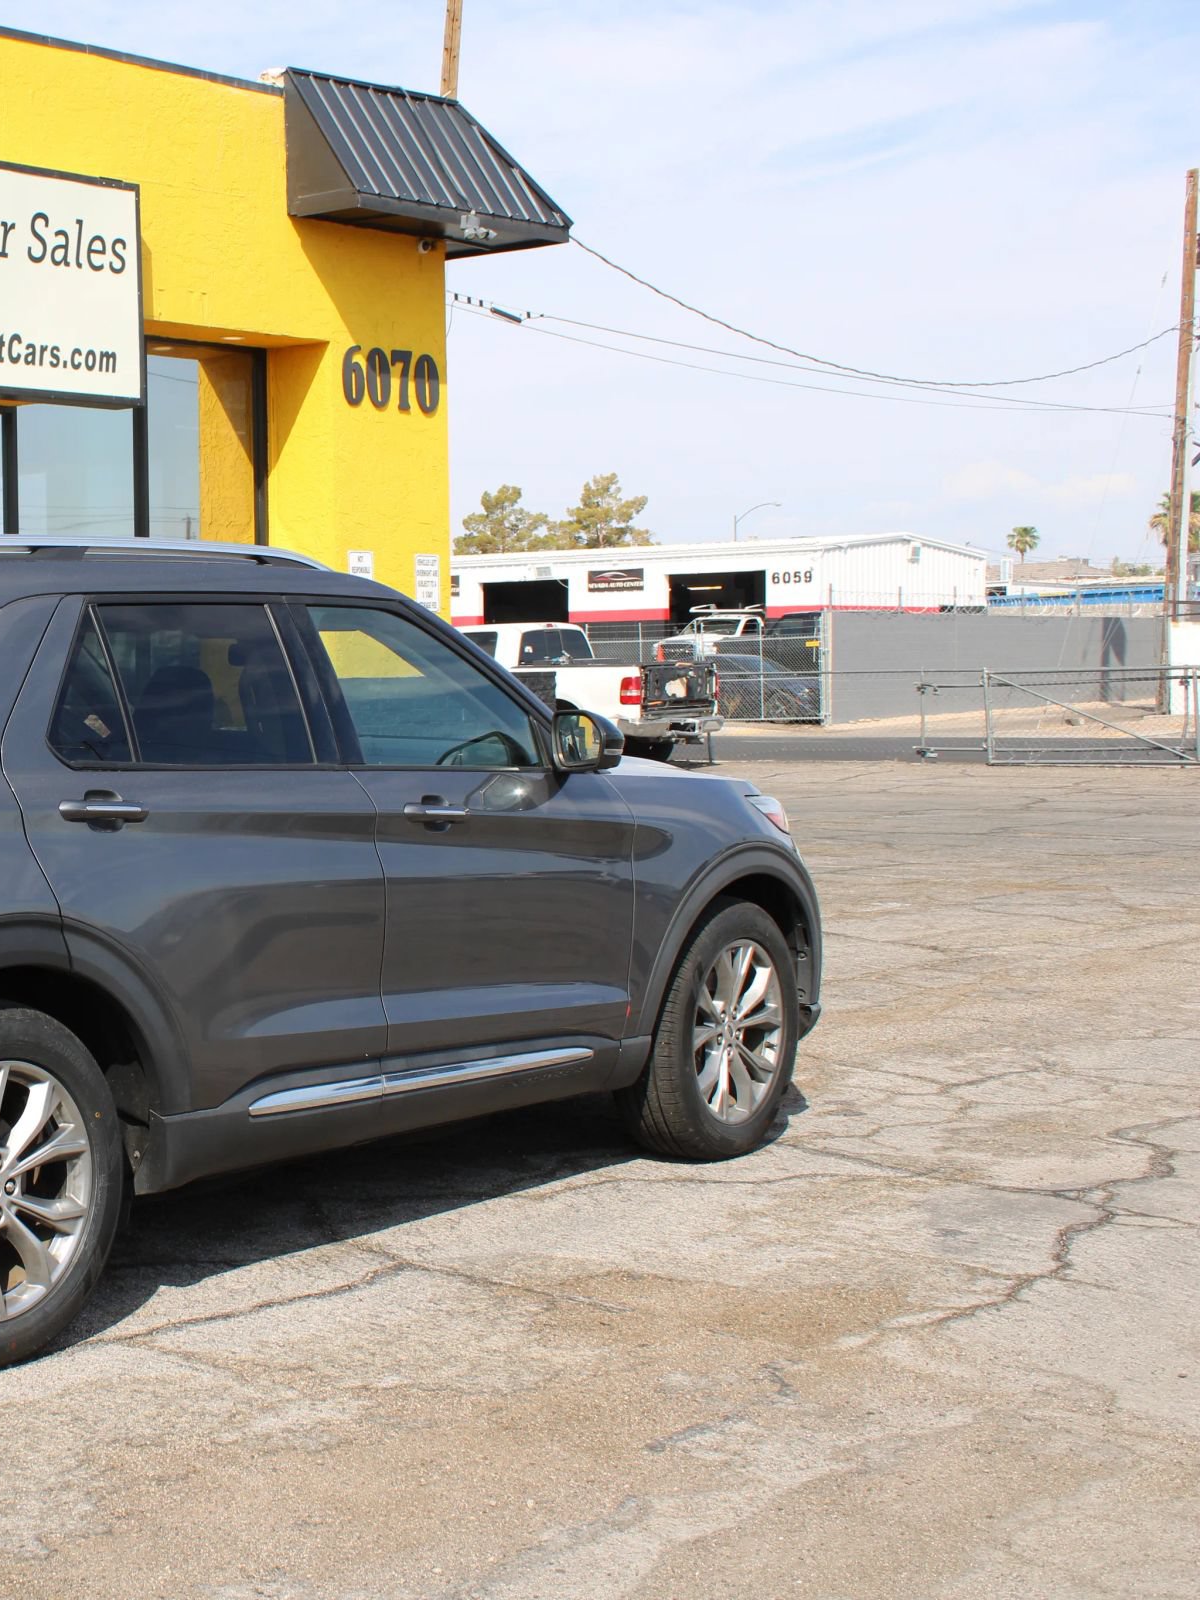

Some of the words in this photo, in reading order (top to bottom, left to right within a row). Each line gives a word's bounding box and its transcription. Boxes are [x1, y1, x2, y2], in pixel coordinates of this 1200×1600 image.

[27, 212, 128, 274] Sales
[342, 344, 440, 414] 6070
[771, 570, 812, 585] 6059
